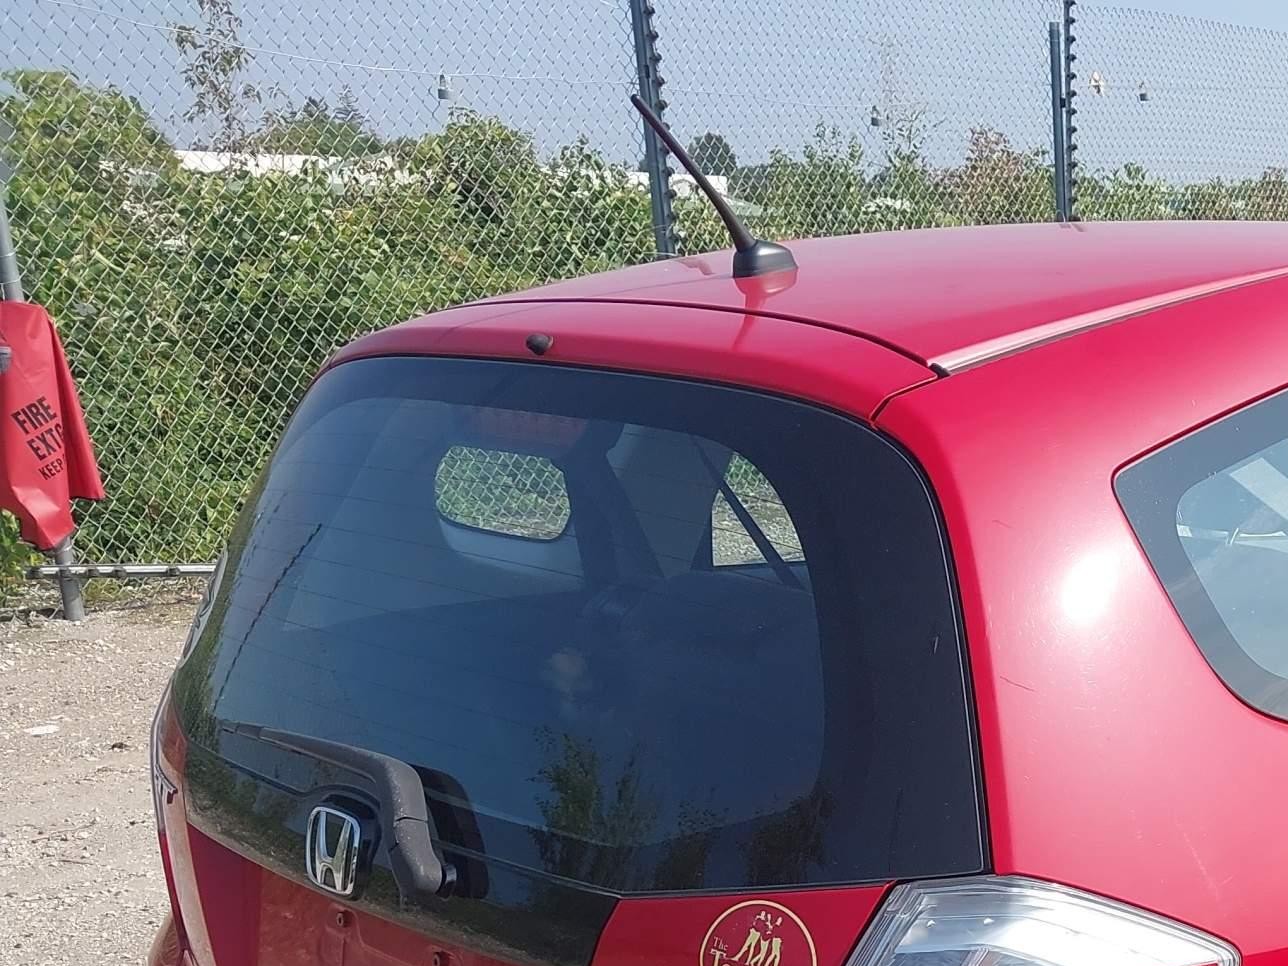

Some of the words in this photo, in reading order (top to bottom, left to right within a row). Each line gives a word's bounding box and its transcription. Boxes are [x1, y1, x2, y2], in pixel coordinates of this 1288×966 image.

[11, 396, 57, 435] FIRE
[38, 458, 64, 480] KEEP
[713, 936, 729, 951] The
